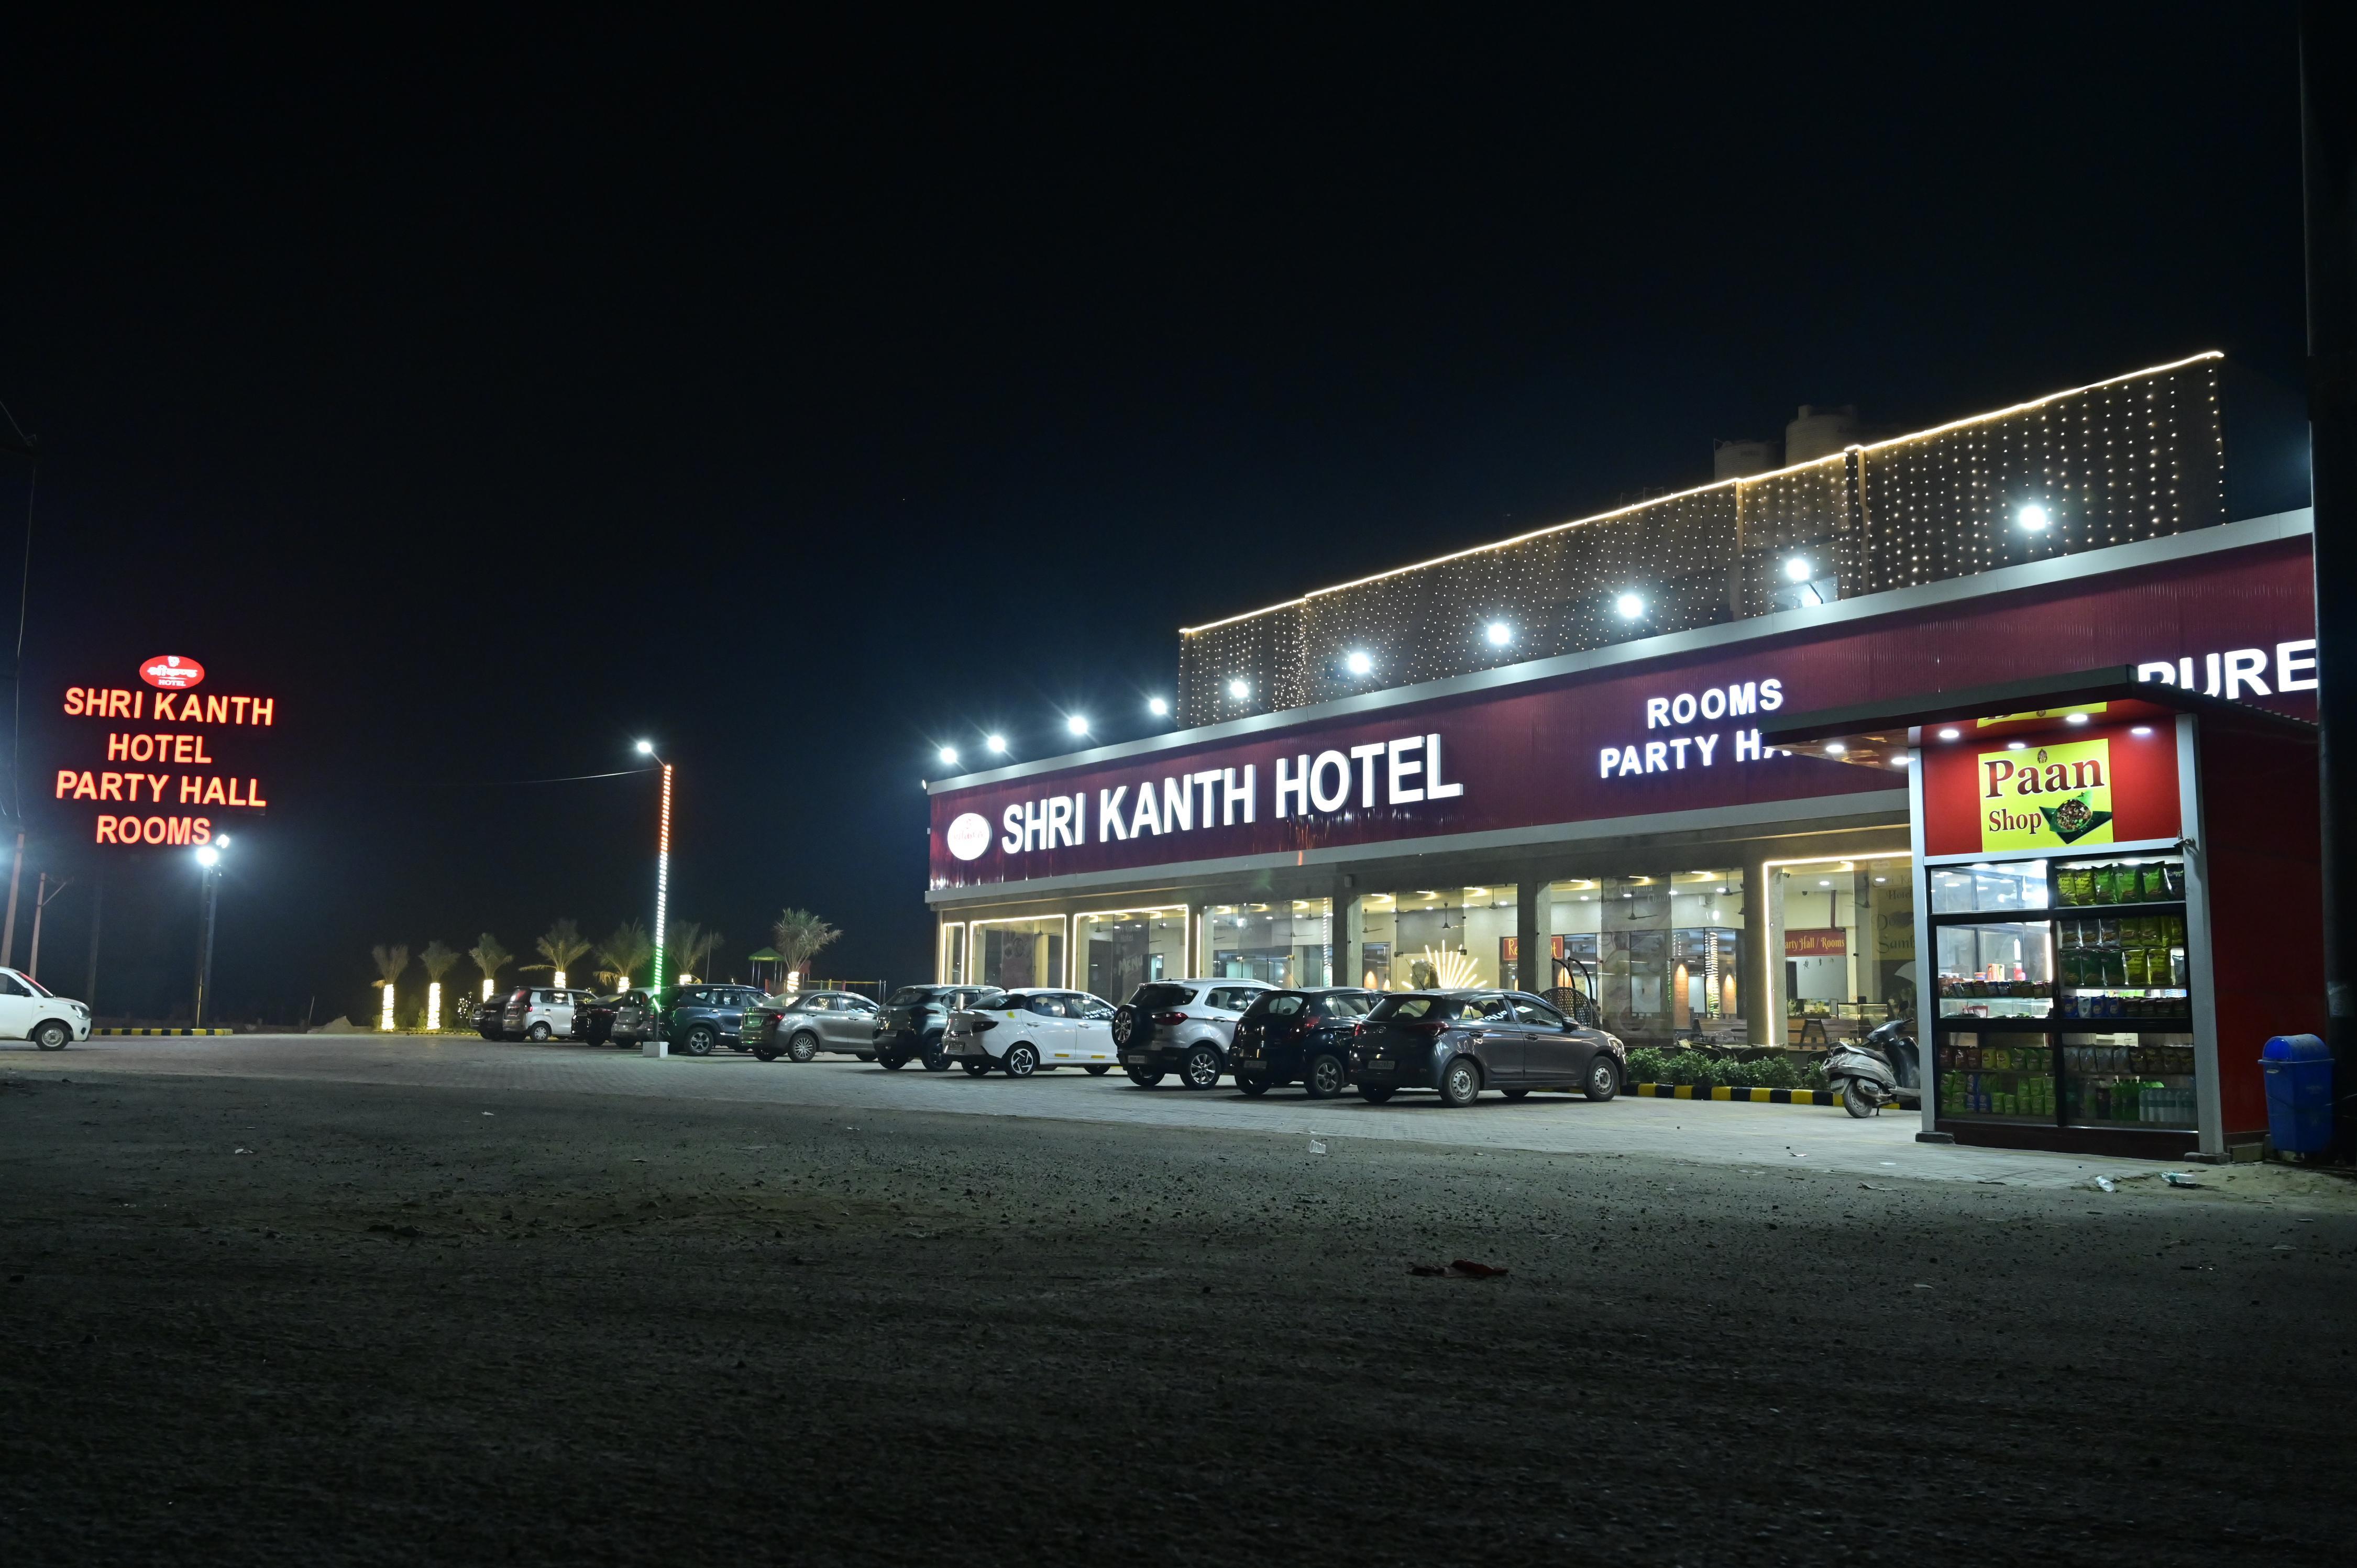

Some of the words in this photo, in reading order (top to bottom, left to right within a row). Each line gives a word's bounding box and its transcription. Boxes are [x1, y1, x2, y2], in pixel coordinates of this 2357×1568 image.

[2138, 638, 2318, 700] PURE
[63, 687, 144, 719] SHRI
[154, 692, 273, 726] KANTH
[1647, 678, 1783, 729] ROOMS
[107, 733, 212, 764] HOTEL
[1600, 734, 1719, 779] PARTY
[56, 770, 170, 802] PARTY
[180, 775, 267, 807] HALL
[1001, 792, 1086, 854] SHRI
[1099, 764, 1256, 843] KANTH
[1275, 733, 1463, 819] HOTEL
[1984, 759, 2105, 798] Paan
[96, 814, 211, 845] ROOMS
[1989, 808, 2042, 835] Shop
[1785, 940, 1798, 952] arty
[1799, 935, 1814, 951] Hall
[1821, 936, 1845, 950] Rooms
